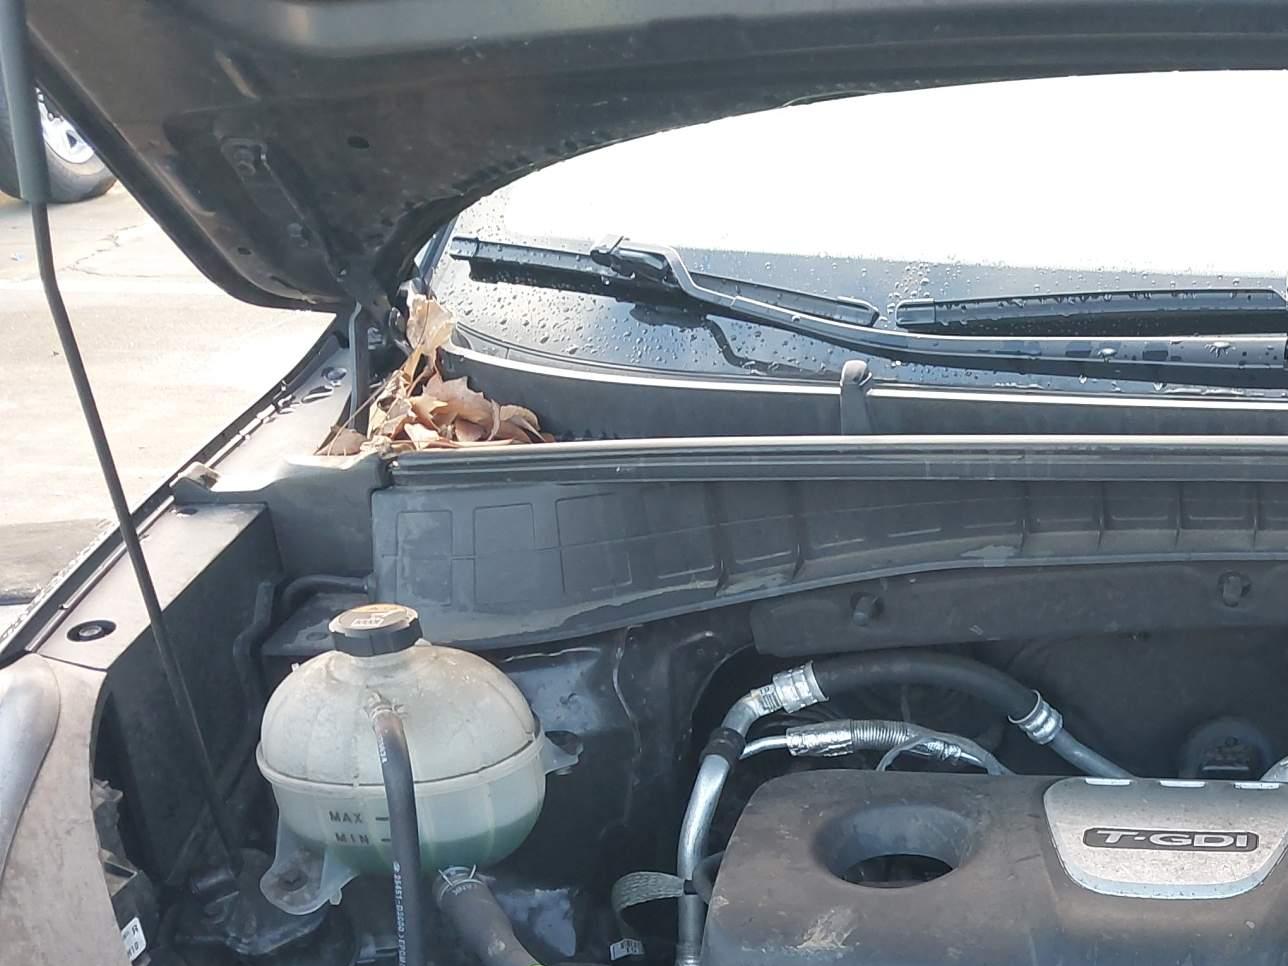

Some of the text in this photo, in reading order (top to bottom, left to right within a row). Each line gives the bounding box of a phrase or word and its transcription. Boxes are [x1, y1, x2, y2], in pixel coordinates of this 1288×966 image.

[328, 810, 364, 824] MAX
[335, 832, 370, 845] MIN
[1097, 830, 1250, 848] T-GDI
